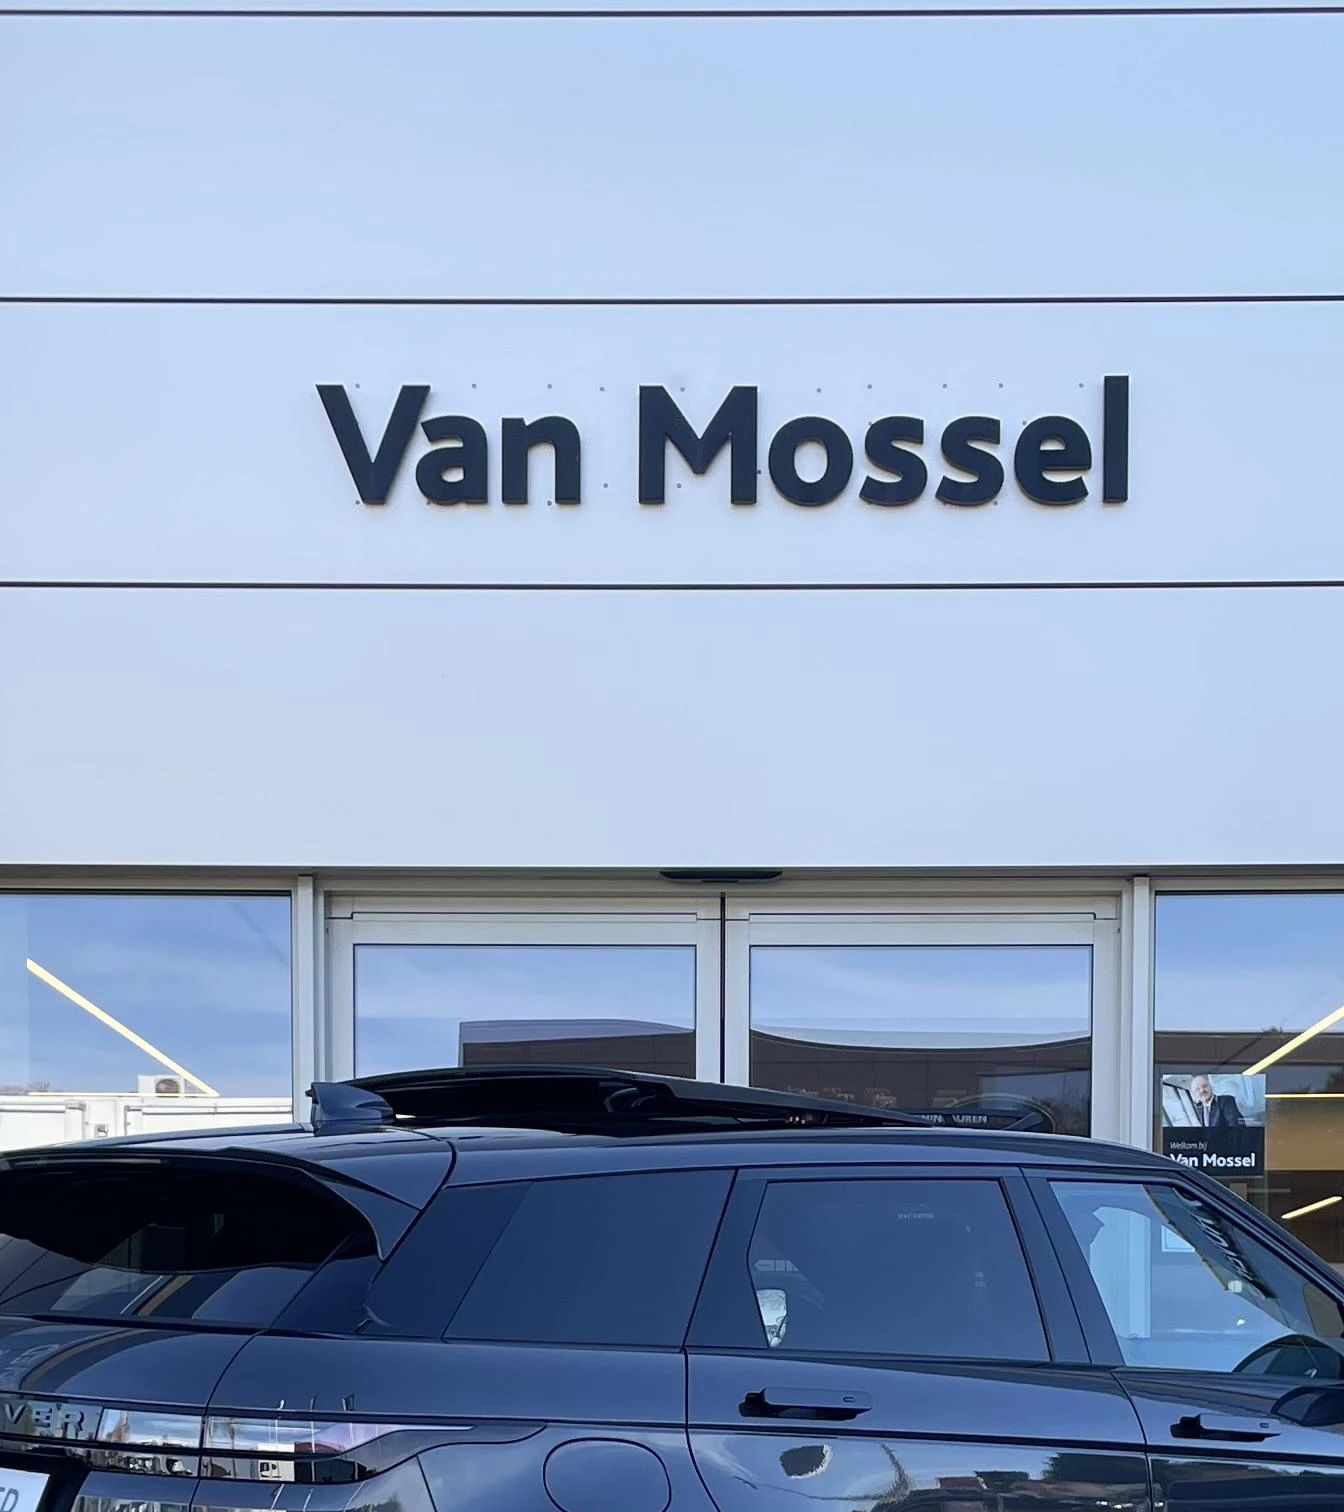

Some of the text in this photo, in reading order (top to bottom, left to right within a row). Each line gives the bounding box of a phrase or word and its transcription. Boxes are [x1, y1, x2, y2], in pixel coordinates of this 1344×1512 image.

[315, 374, 1131, 506] Van Mossel
[1169, 1141, 1197, 1151] Welkom
[1169, 1152, 1255, 1167] Van Mossel
